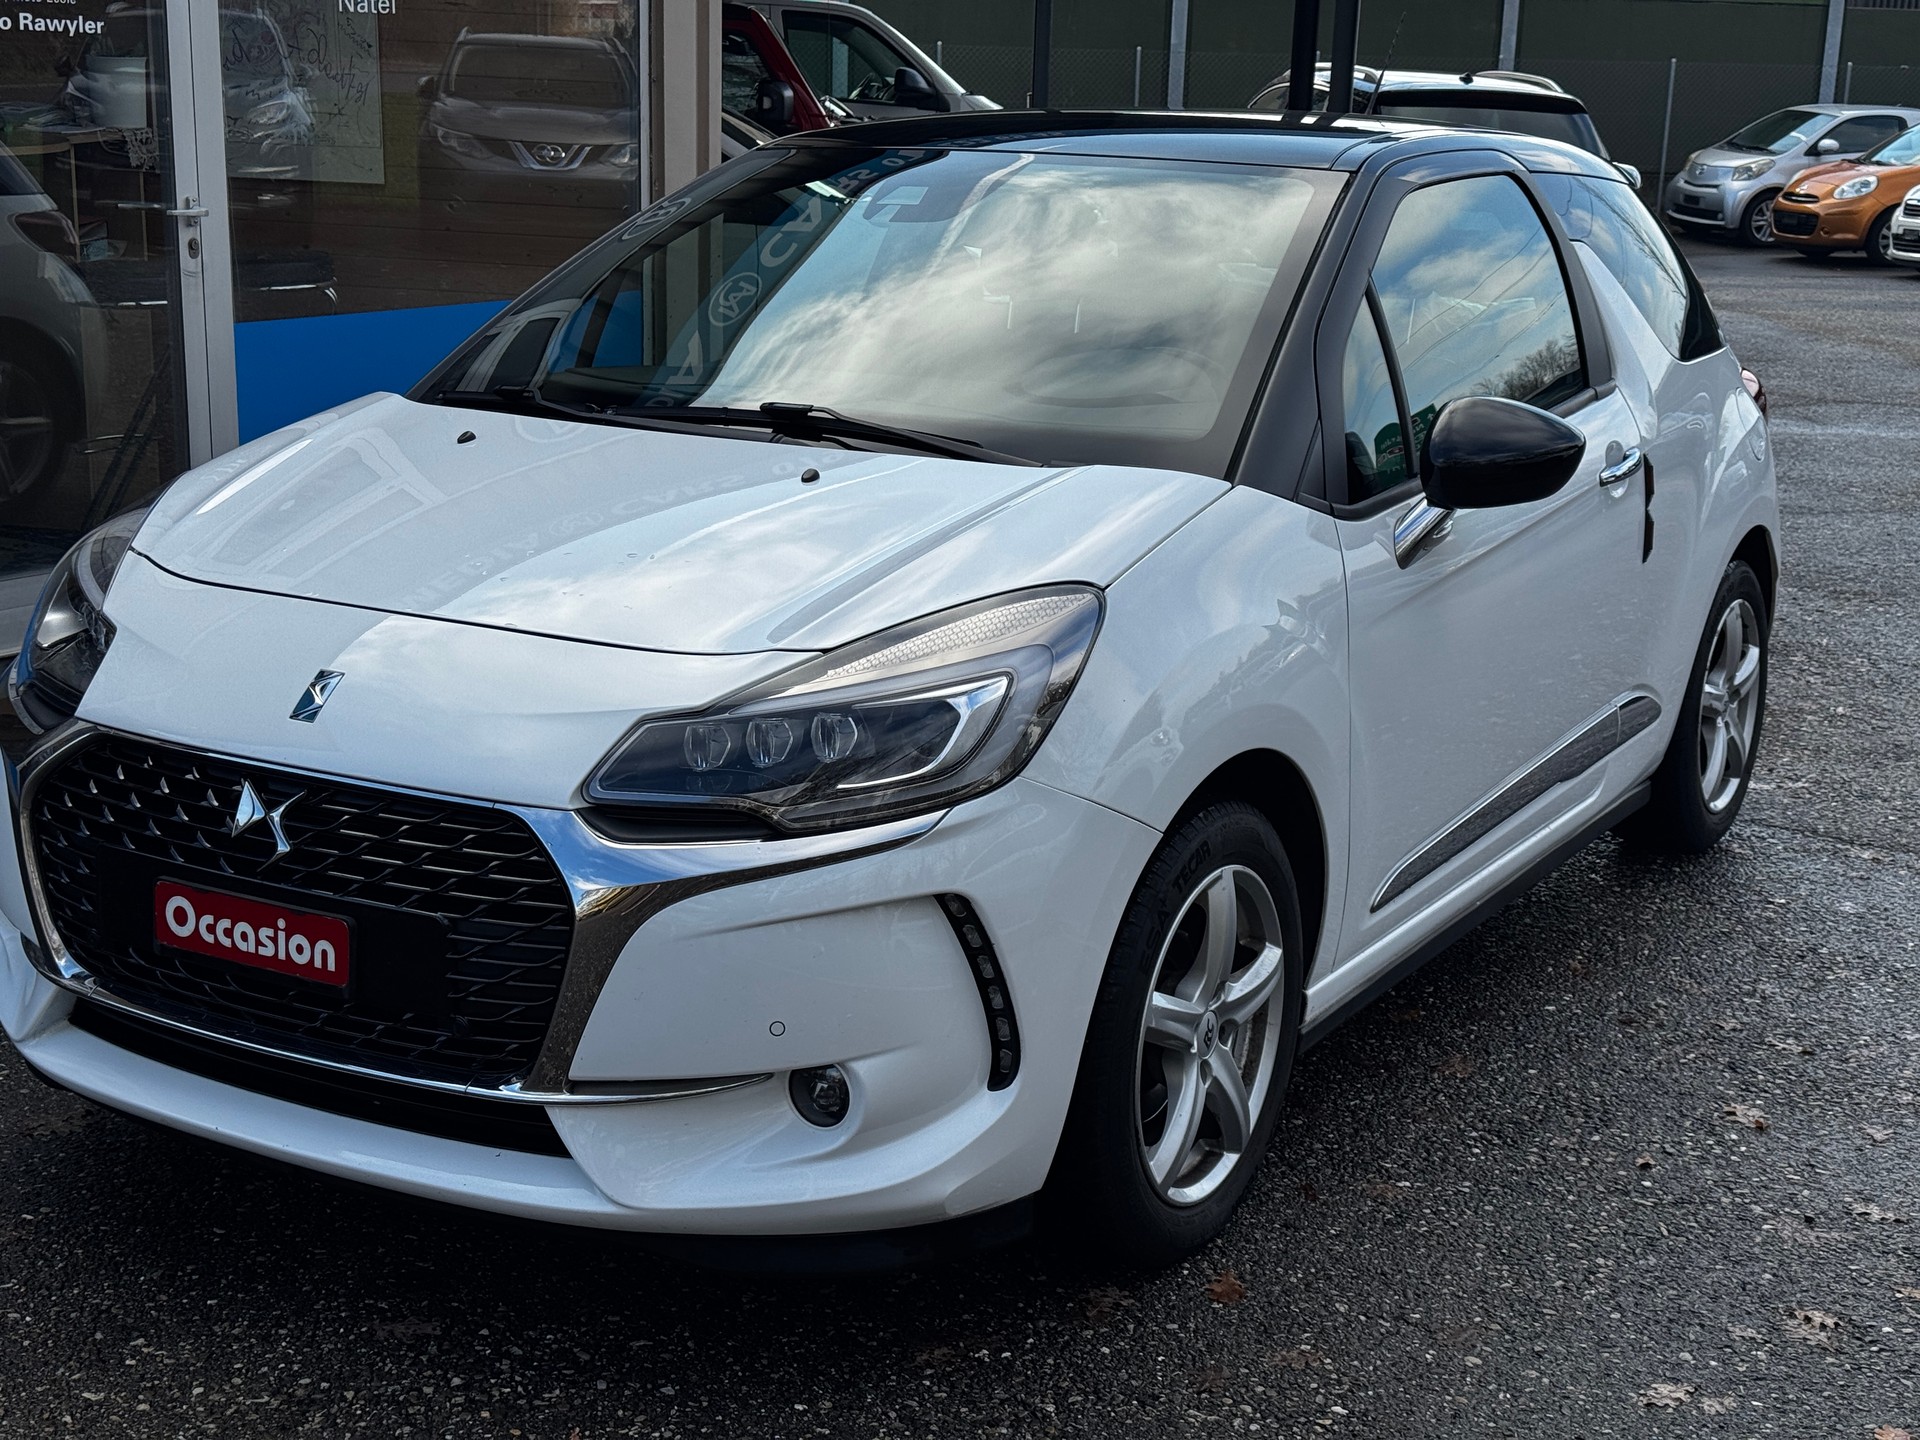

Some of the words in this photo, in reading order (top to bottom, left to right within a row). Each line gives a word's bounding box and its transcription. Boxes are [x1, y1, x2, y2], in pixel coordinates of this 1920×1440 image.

[18, 12, 105, 37] Rawyler
[1171, 839, 1212, 894] TECAR
[164, 894, 337, 973] Occasion
